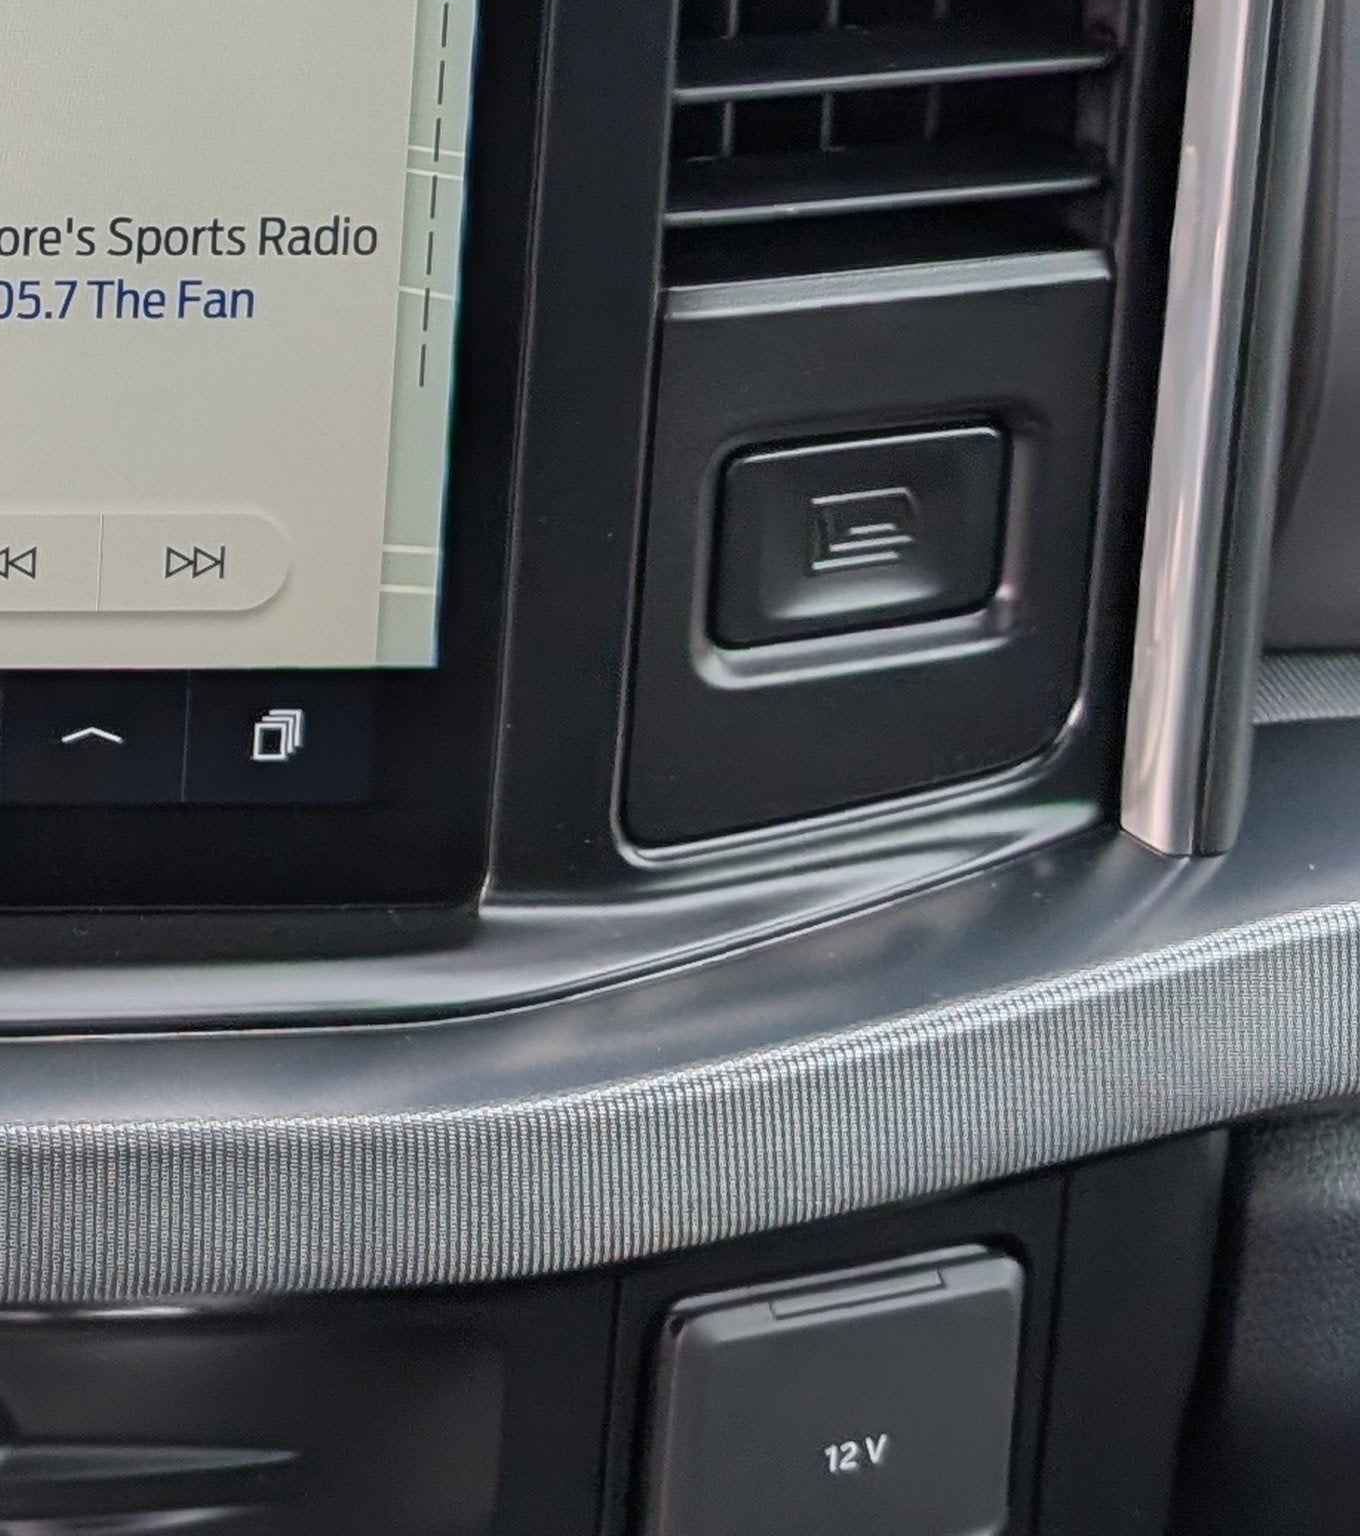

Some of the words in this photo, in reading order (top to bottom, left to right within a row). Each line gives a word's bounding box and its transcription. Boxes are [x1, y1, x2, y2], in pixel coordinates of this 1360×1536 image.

[107, 217, 246, 264] Sports
[259, 215, 378, 256] Radio
[87, 278, 166, 319] The
[178, 280, 254, 319] Fan
[825, 1441, 859, 1472] 12
[865, 1434, 887, 1464] V
